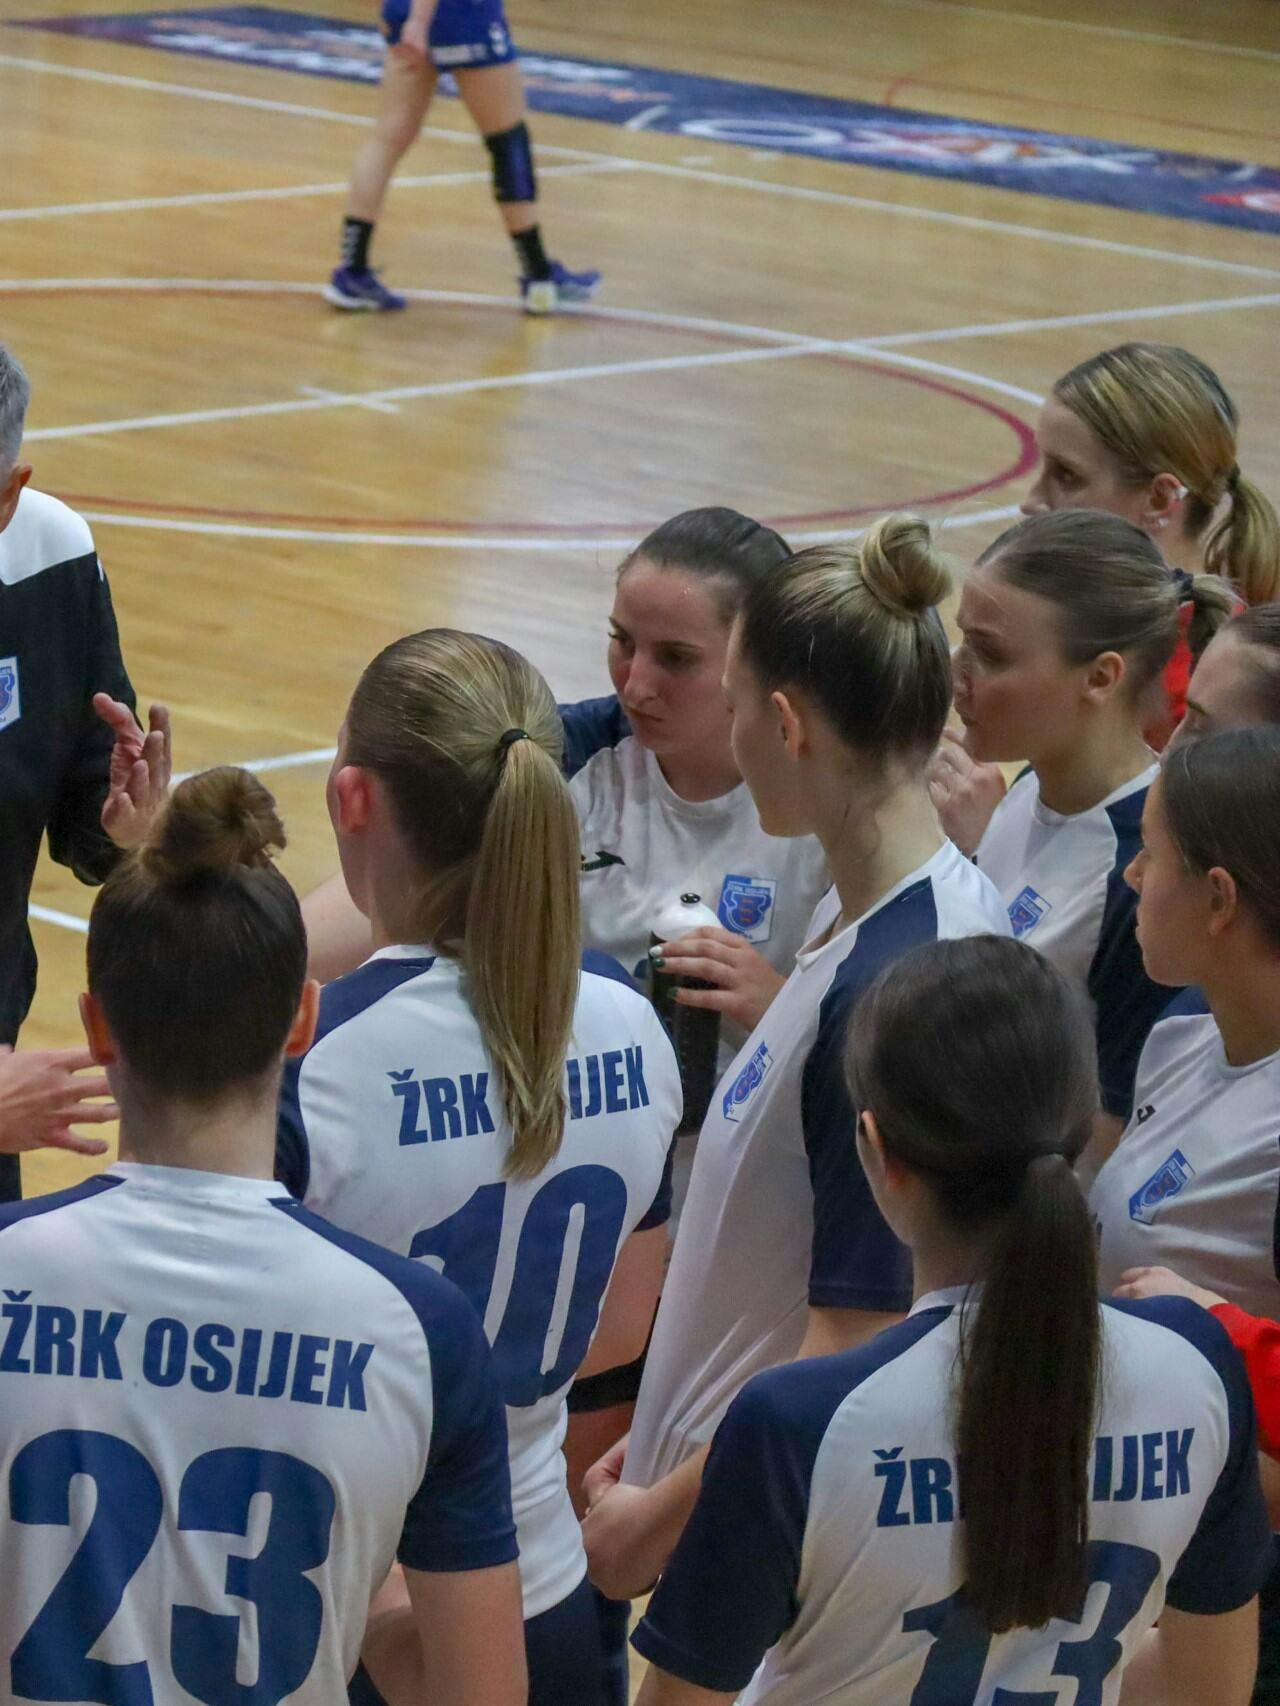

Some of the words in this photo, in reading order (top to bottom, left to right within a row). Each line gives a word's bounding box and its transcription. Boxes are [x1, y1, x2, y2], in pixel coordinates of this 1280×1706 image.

[386, 1067, 496, 1147] ŽRK
[566, 1044, 650, 1120] IJEK
[408, 1163, 628, 1408] 10
[142, 1317, 376, 1413] OSIJEK
[872, 1446, 965, 1528] ŽR
[1092, 1427, 1196, 1503] IJEK
[8, 1428, 337, 1706] 23
[901, 1539, 1162, 1706] 13
